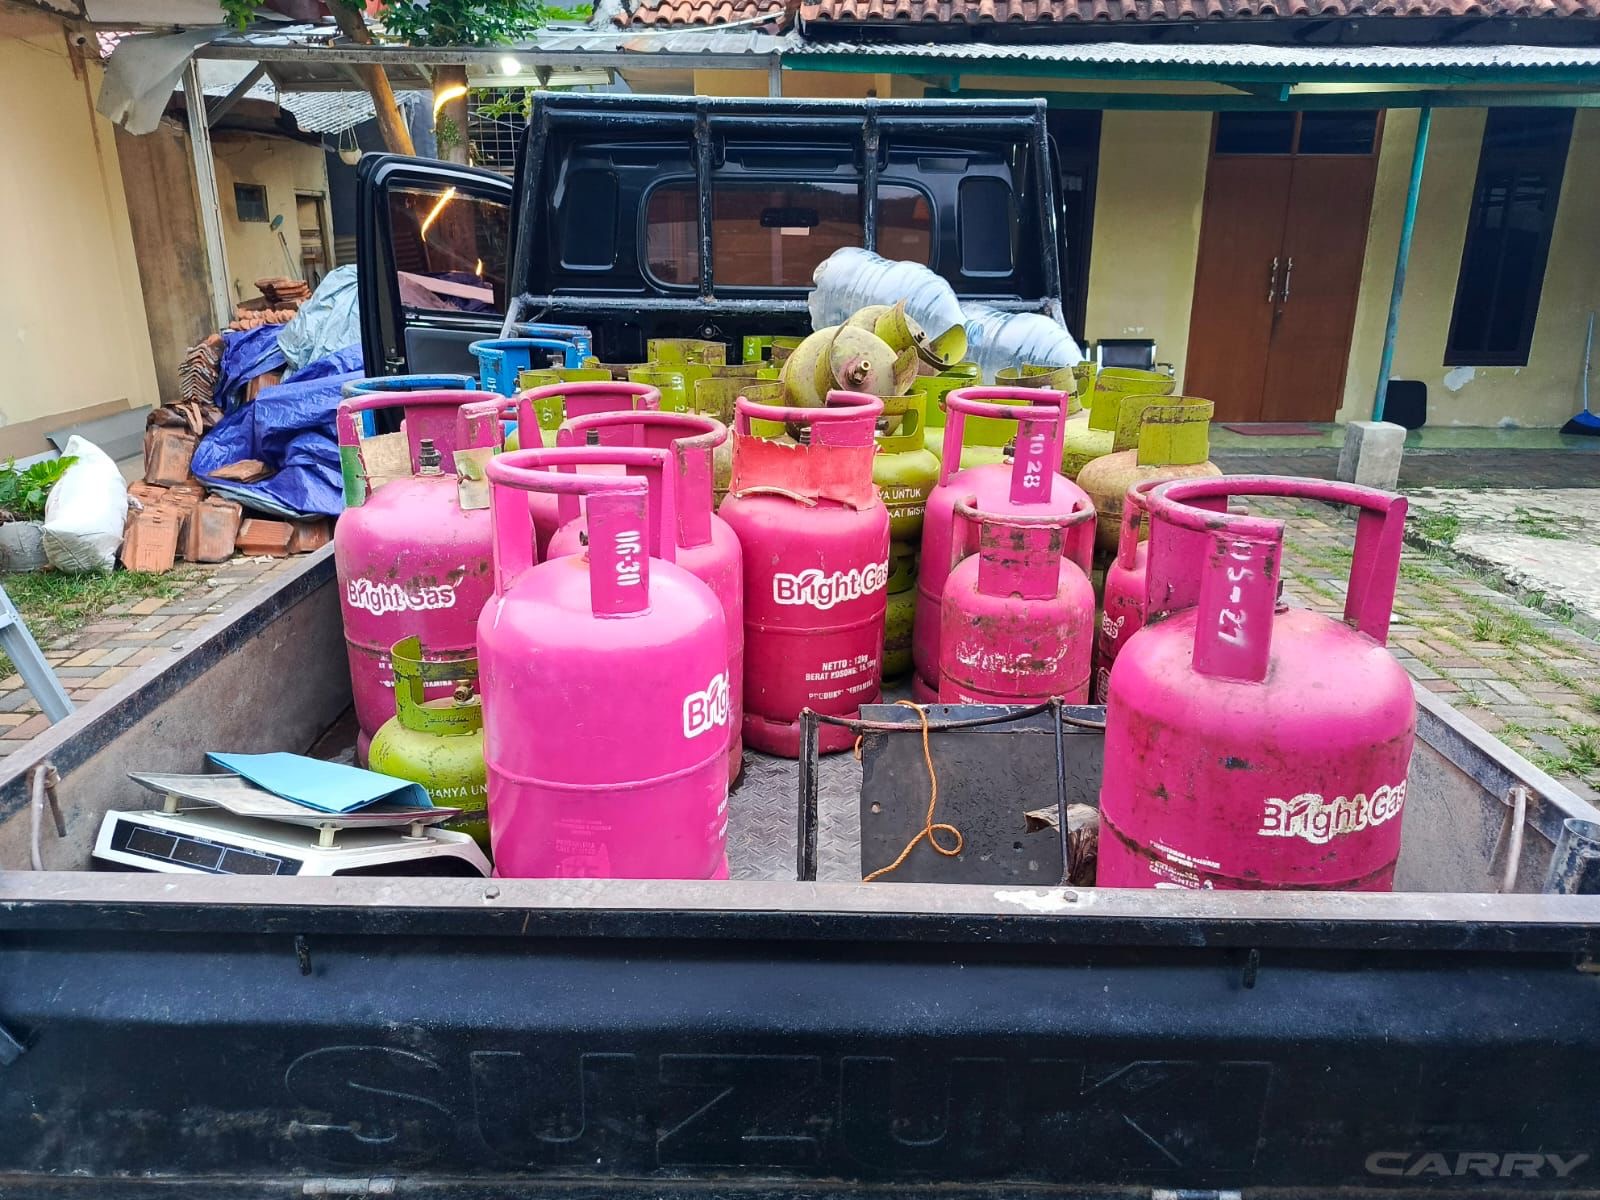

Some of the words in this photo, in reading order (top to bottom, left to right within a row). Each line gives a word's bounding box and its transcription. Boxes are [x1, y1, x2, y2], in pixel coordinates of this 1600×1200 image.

[892, 488, 921, 500] UNTUK
[773, 568, 862, 610] Bright
[822, 660, 848, 672] NETTO
[805, 672, 829, 681] BERAT
[283, 1044, 1276, 1169] SUZUKI
[1364, 1150, 1591, 1178] CARRY
